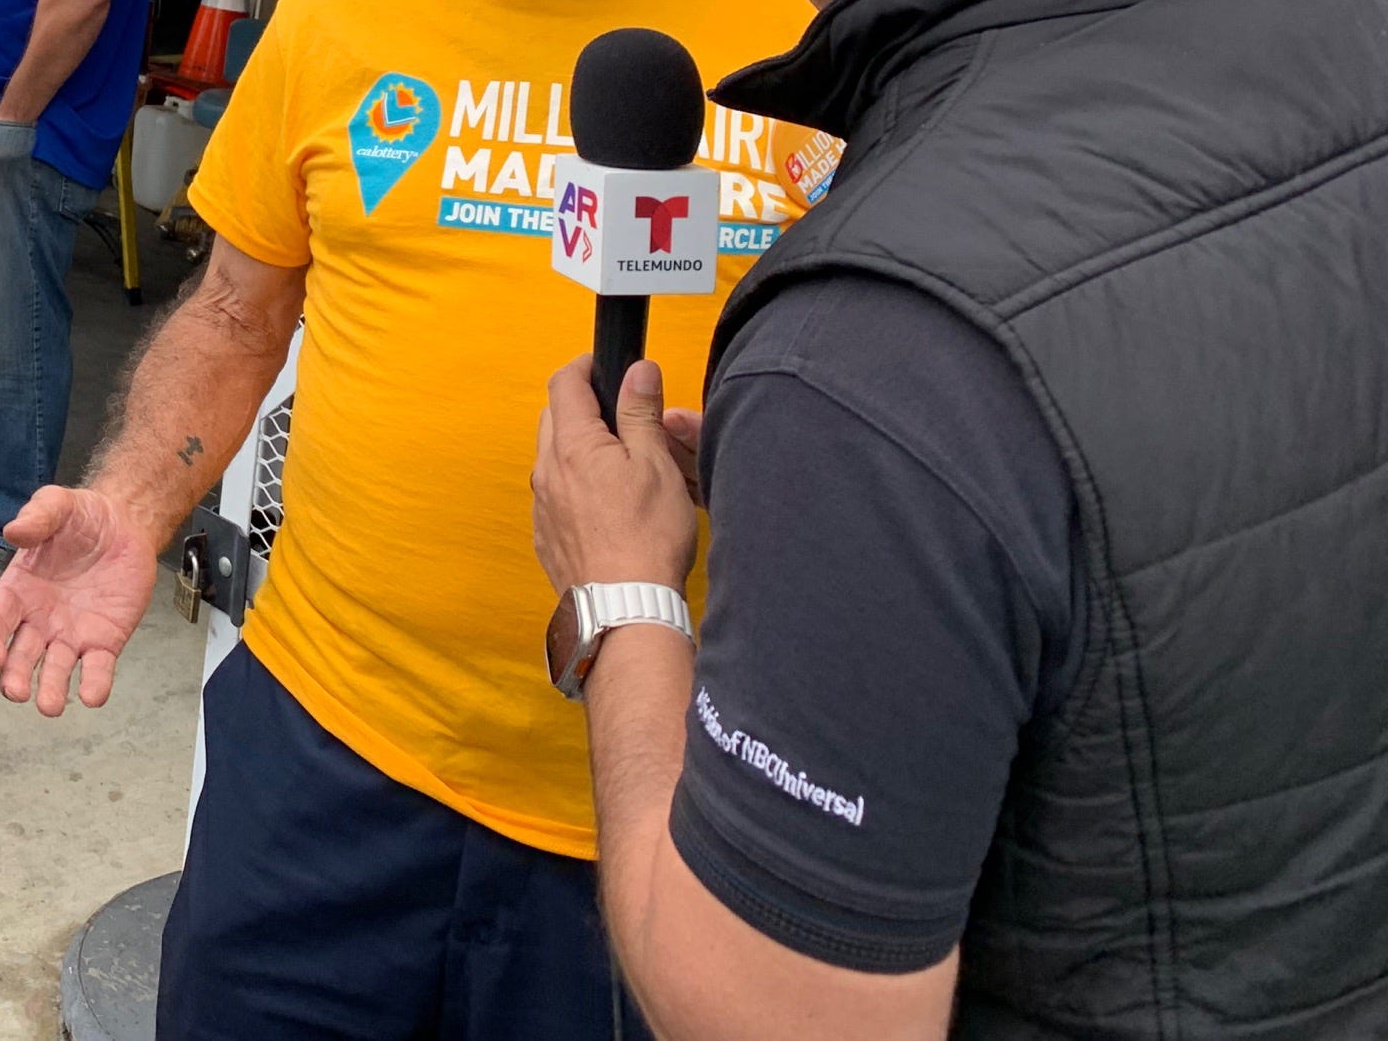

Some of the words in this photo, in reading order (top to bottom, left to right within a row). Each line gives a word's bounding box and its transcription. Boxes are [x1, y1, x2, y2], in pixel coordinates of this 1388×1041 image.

[797, 150, 837, 194] MADE
[720, 171, 790, 223] RE
[445, 202, 501, 227] JOIN
[508, 207, 554, 232] THE
[719, 227, 773, 249] RCLE
[617, 259, 703, 271] TELEMUNDO
[720, 730, 746, 756] of
[741, 735, 864, 827] NBCUniversal
